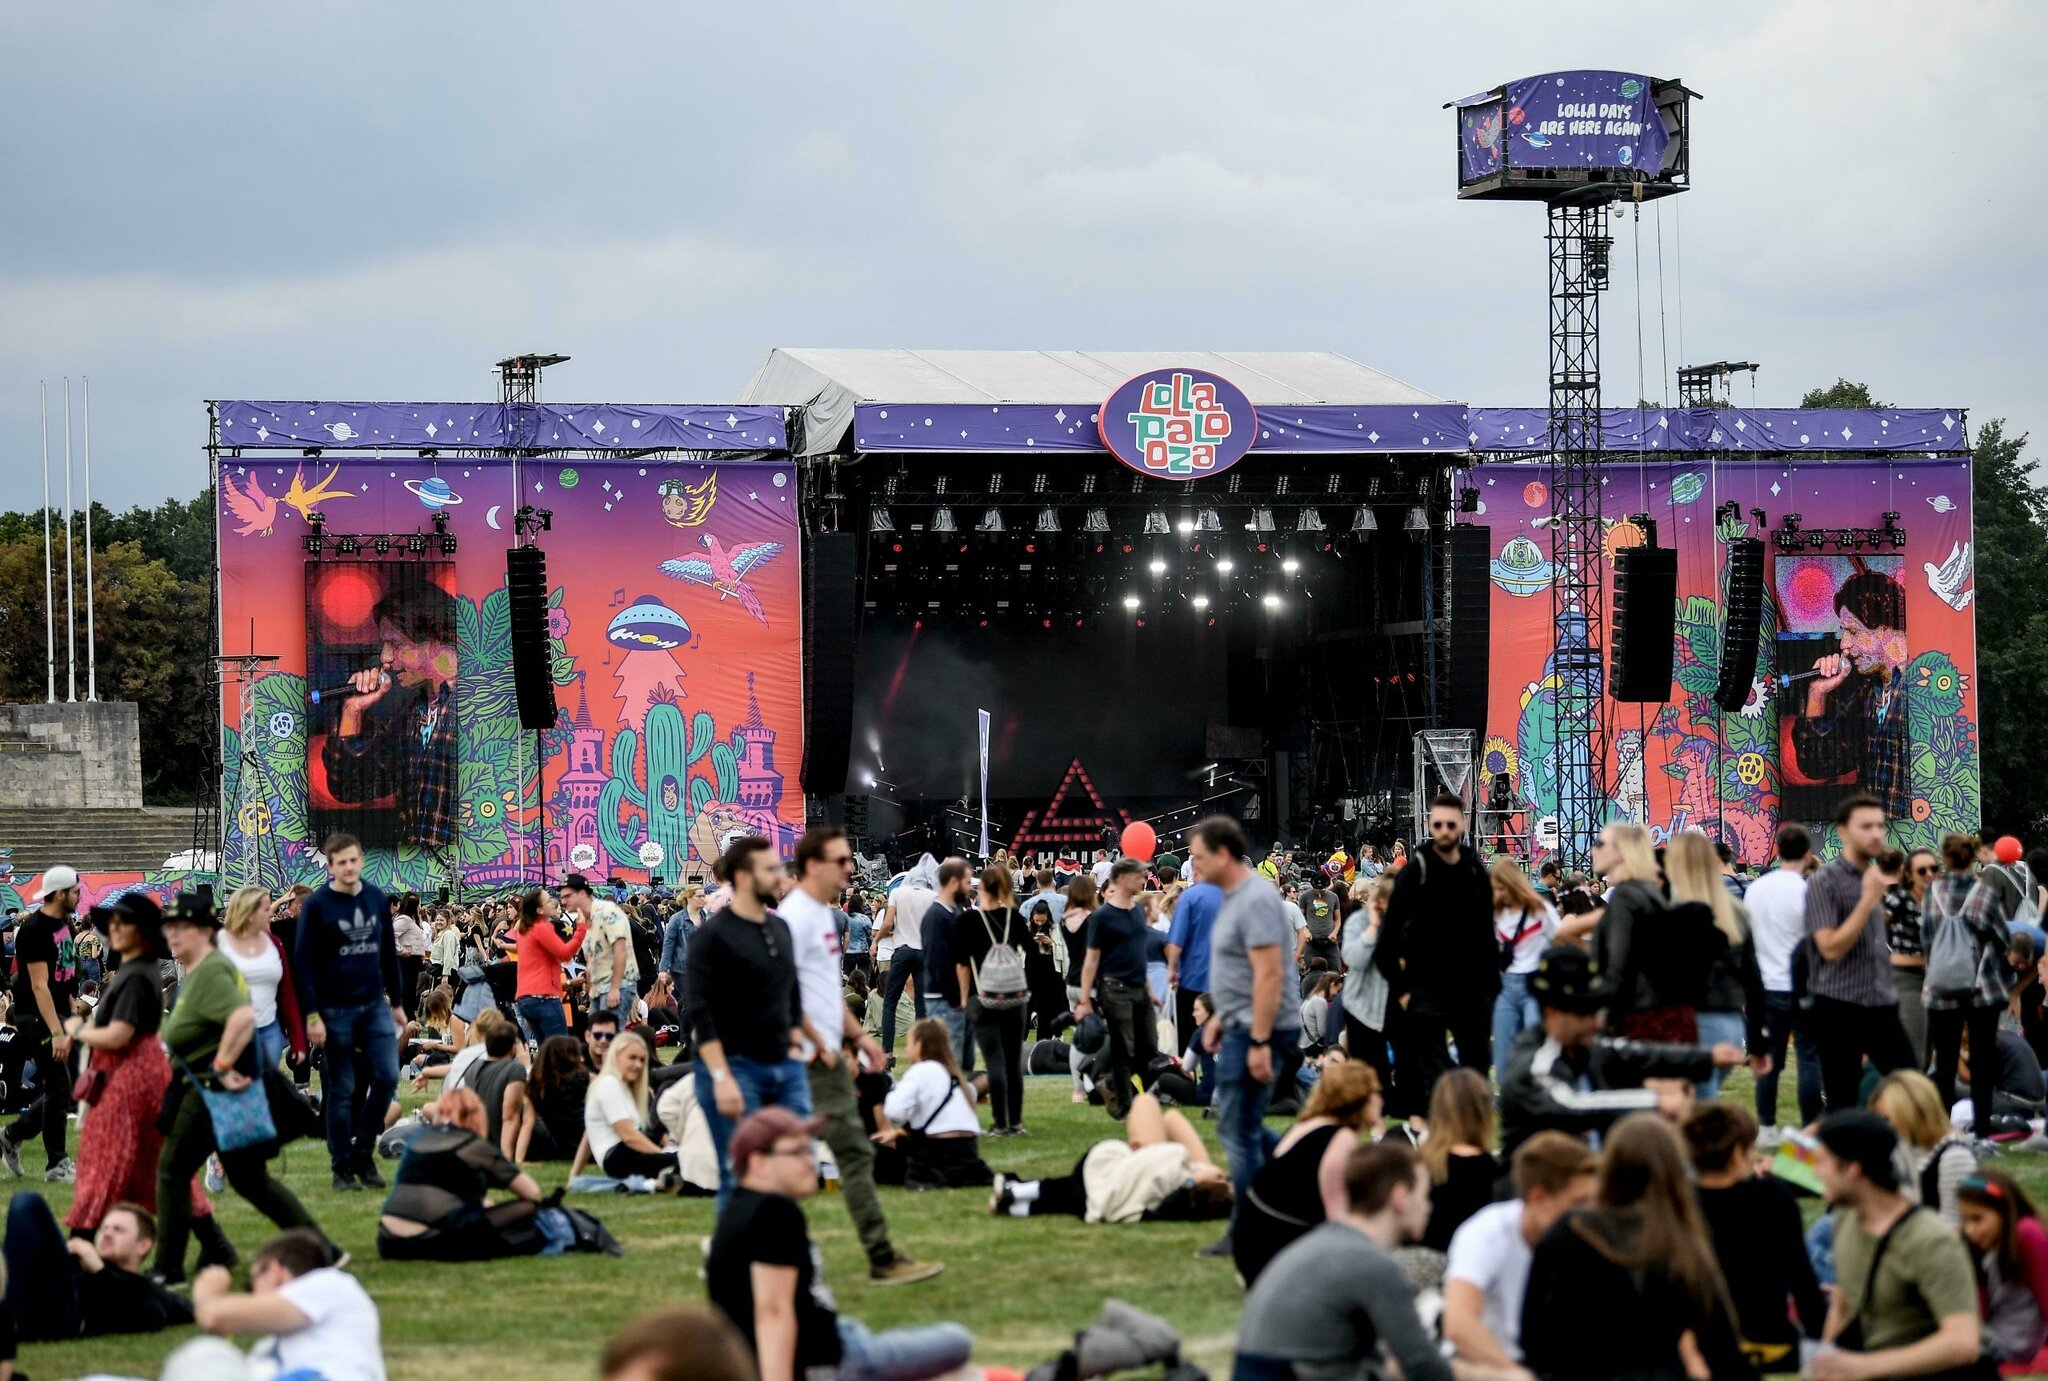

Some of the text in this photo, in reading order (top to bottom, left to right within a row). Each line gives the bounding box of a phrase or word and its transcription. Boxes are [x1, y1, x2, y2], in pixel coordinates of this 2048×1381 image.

[1558, 103, 1632, 119] LOLLA DAYS
[1539, 120, 1642, 136] ARE HERE AGAIN
[340, 942, 378, 956] adidas
